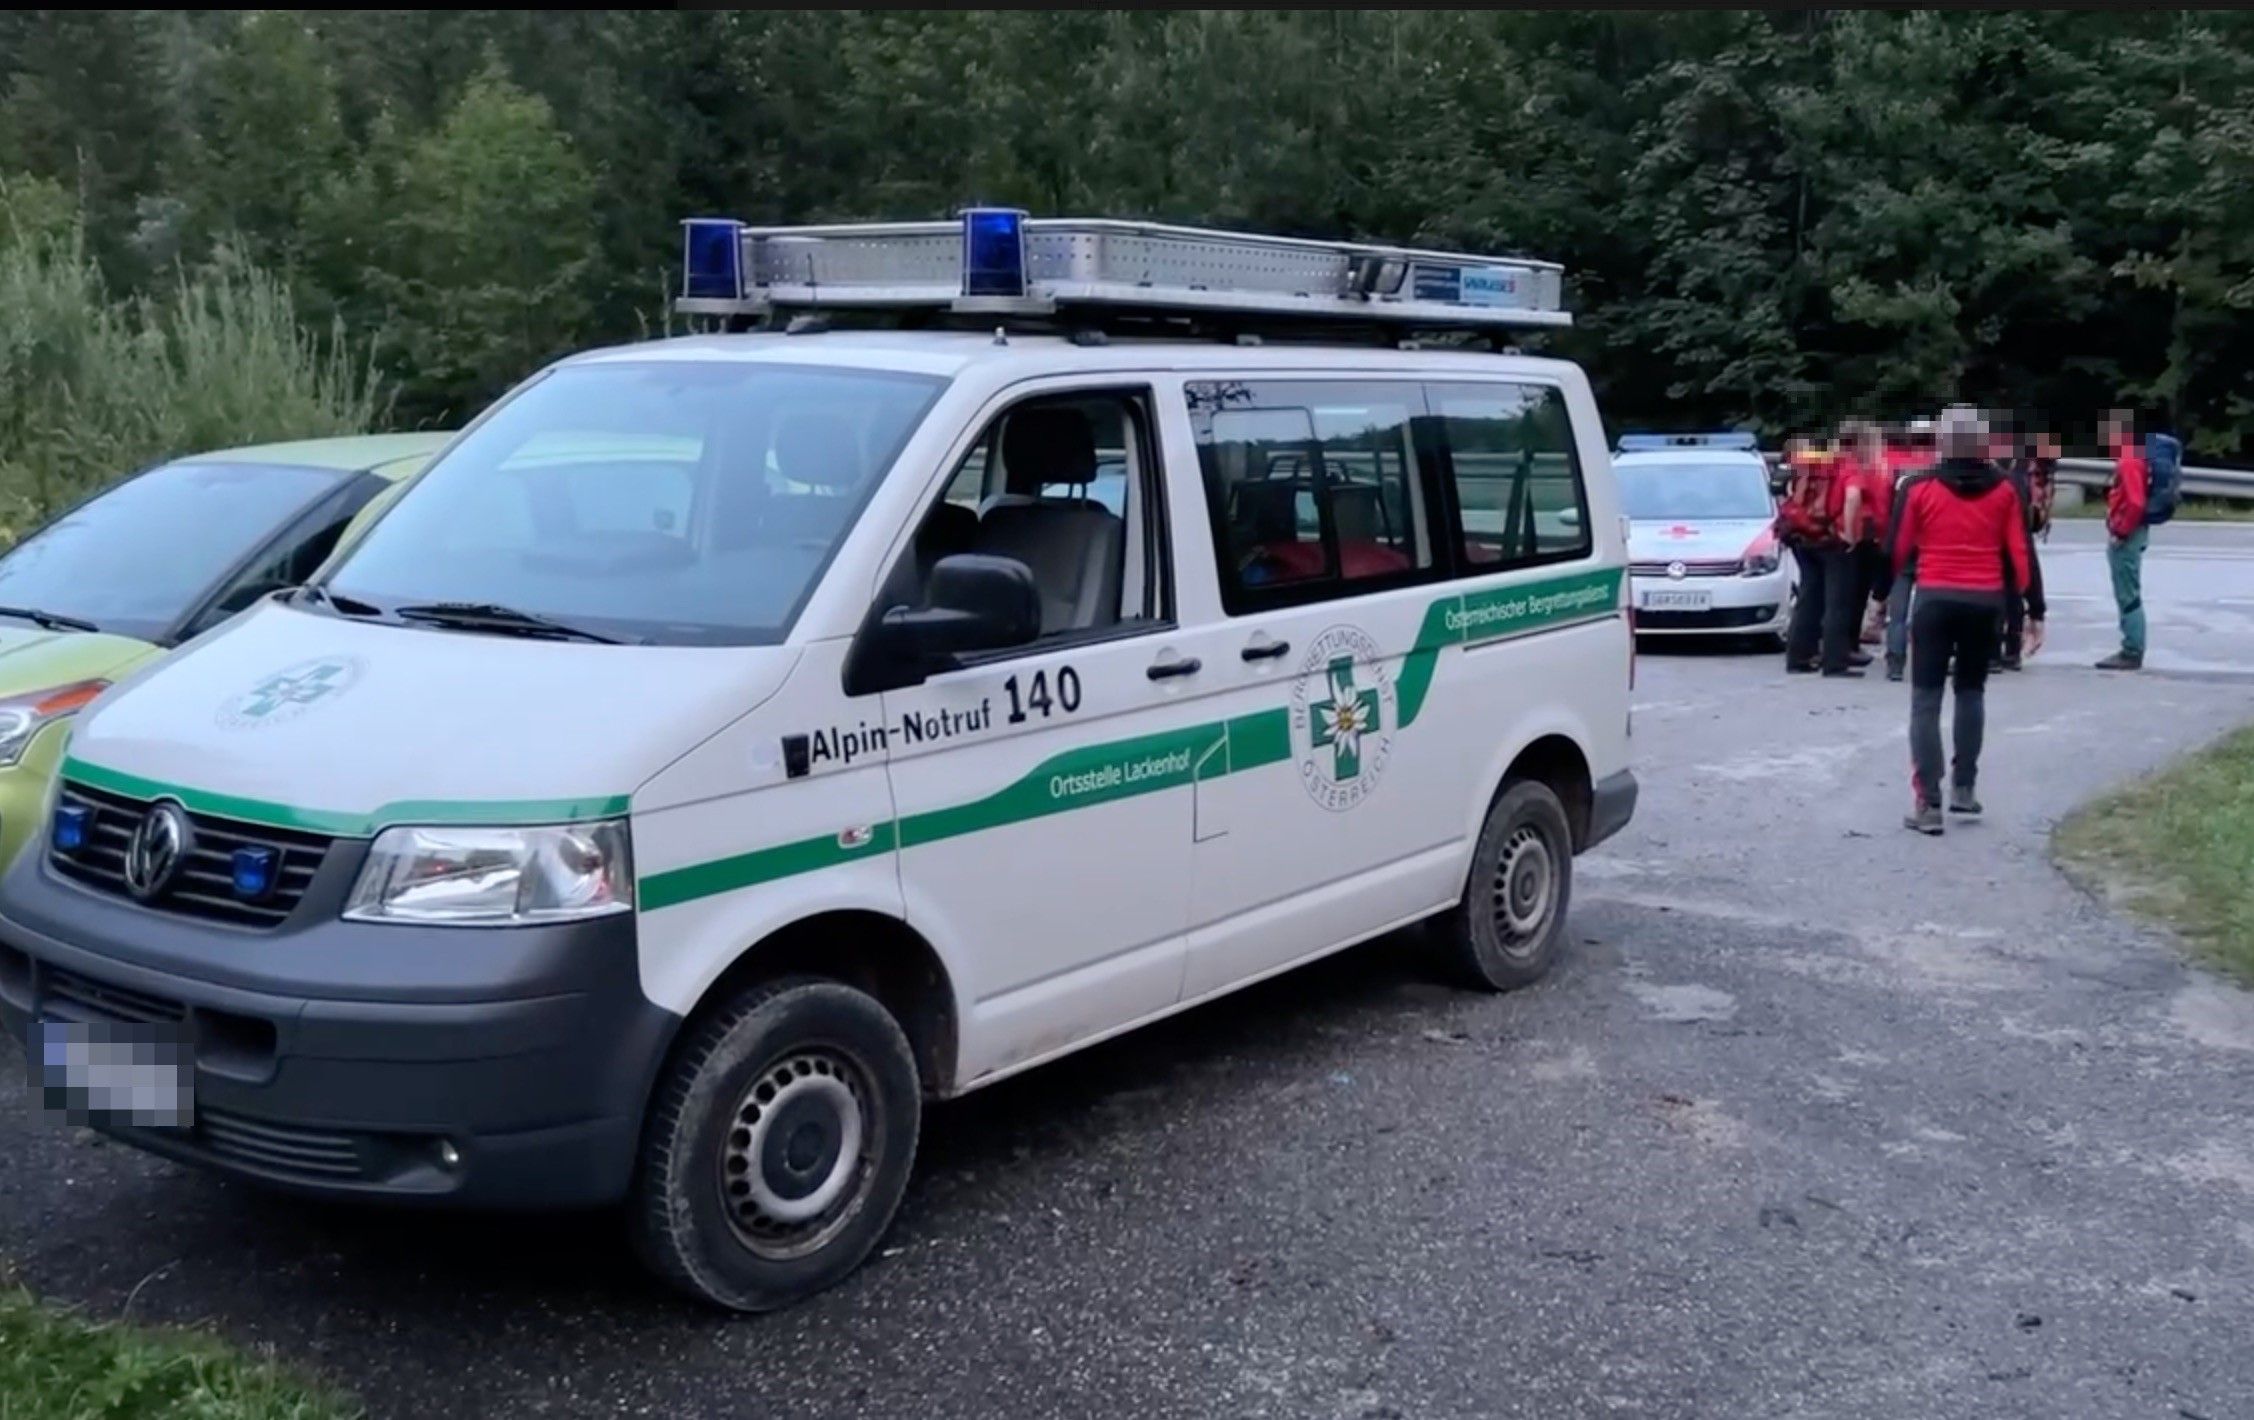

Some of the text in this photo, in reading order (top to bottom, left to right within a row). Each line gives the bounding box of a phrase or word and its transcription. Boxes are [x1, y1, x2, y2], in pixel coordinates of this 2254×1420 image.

[811, 665, 1081, 763] Alpin-Notruf 140
[1051, 748, 1191, 798] Ortsstelle Lackenhof
